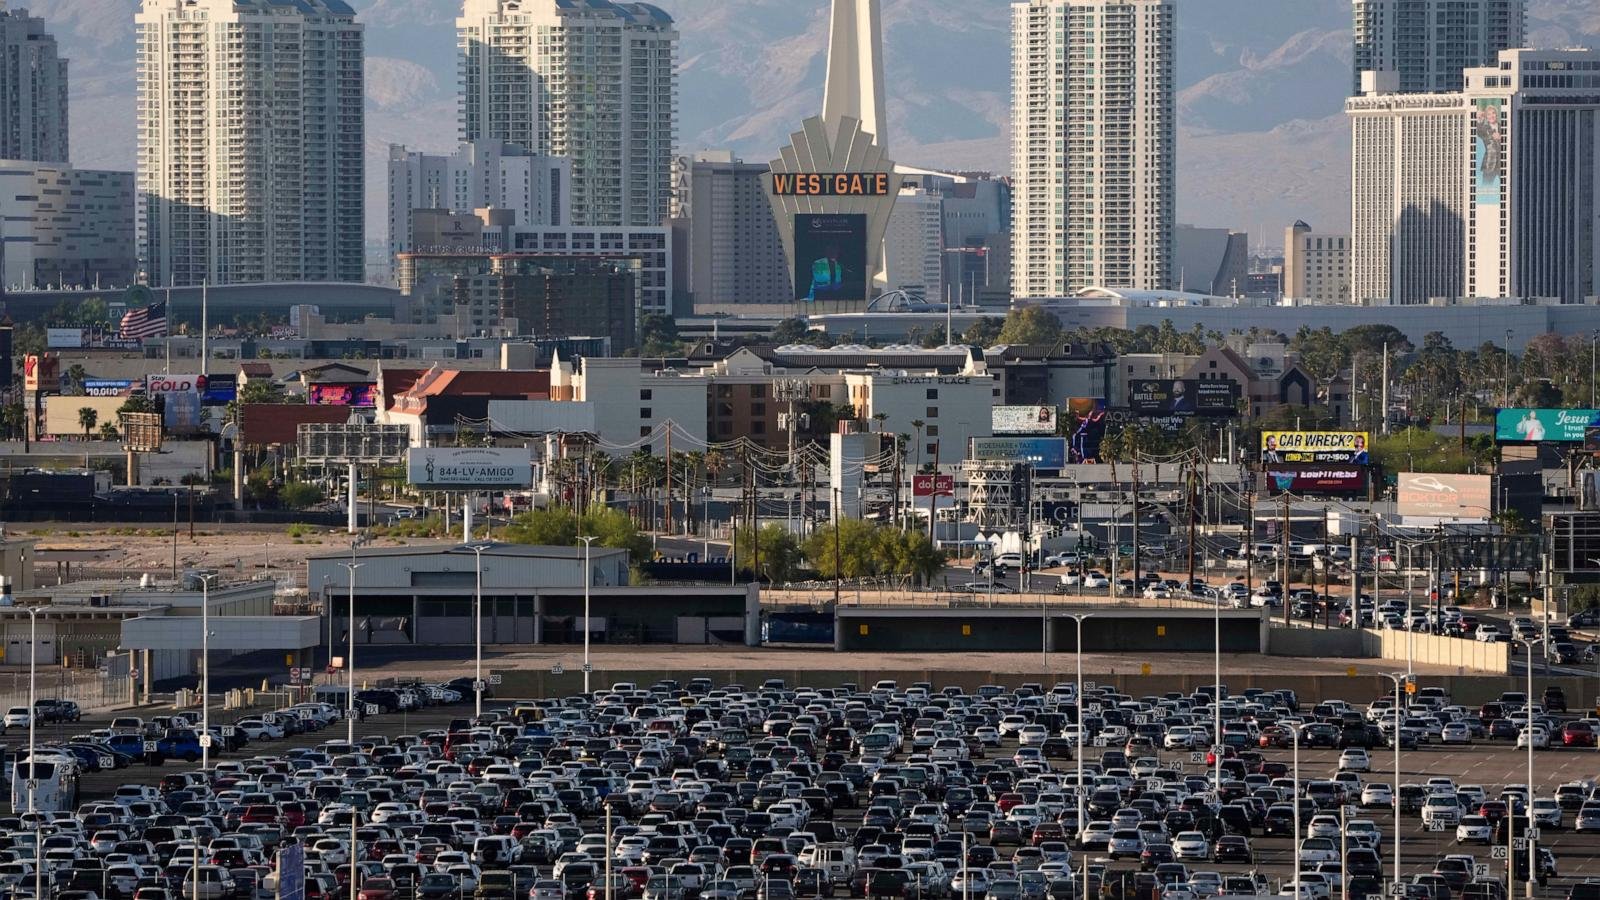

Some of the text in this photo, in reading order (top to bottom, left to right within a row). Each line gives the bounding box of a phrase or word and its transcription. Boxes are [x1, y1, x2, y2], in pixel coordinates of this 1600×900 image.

[774, 174, 887, 194] WESTGATE
[901, 377, 971, 385] HYATT PLACE
[150, 381, 191, 392] GOLD
[1555, 410, 1590, 425] Jesus
[1280, 434, 1353, 446] CAR WRECK?
[439, 467, 514, 476] 844-LV-AMIGO
[367, 705, 377, 714] 2X
[1090, 703, 1100, 712] 2X
[264, 714, 274, 722] 2U
[301, 710, 312, 718] 2V
[1136, 716, 1146, 725] 2V
[1116, 727, 1126, 736] 2U
[144, 742, 155, 751] 2R
[1213, 745, 1223, 754] 2S
[1192, 753, 1203, 761] 2R
[101, 757, 113, 767] 2Q
[1171, 762, 1182, 771] 2Q
[60, 764, 70, 773] 2P
[1149, 781, 1158, 790] 2P
[1076, 786, 1086, 795] 2N
[1205, 794, 1217, 803] 2M
[1431, 820, 1443, 829] 2K
[1527, 829, 1538, 839] 2J
[1513, 839, 1524, 848] 2H
[1493, 847, 1506, 857] 2G
[1476, 864, 1487, 875] 2F
[1391, 883, 1404, 894] 2E
